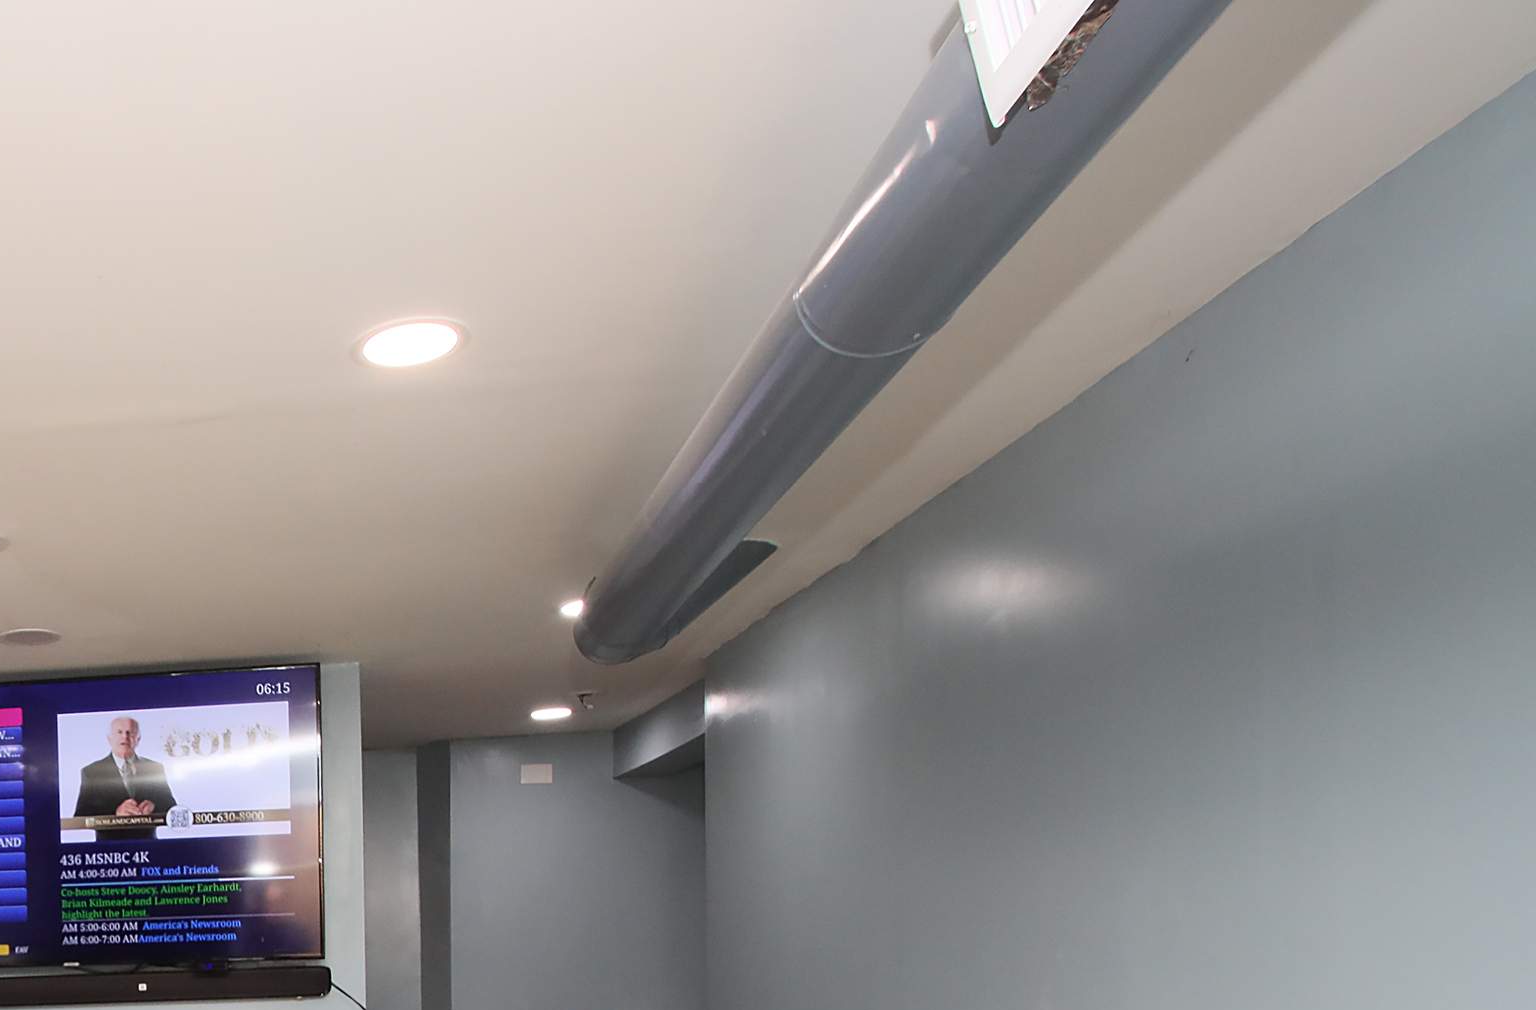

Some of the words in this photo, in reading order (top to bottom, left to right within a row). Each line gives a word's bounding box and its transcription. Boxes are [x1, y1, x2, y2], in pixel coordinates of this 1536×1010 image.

[257, 683, 290, 695] 06:15
[195, 811, 264, 824] 800-630-8900
[60, 855, 82, 866] 436
[85, 853, 129, 865] MSNBC
[132, 852, 149, 863] 4K
[60, 871, 76, 879] AM
[78, 869, 119, 878] 4:00-5:00
[121, 868, 137, 877] AM
[142, 867, 161, 876] FOX
[163, 866, 181, 875] and
[183, 865, 219, 874] Friends
[61, 888, 99, 897] Co-hosts
[101, 887, 126, 896] Steve
[161, 884, 195, 896] Ainsley
[197, 883, 242, 893] Earhardt,
[62, 899, 87, 908] Brian
[89, 898, 132, 907] Kilmeade
[134, 897, 152, 906] and
[155, 896, 200, 906] Lawrence
[202, 895, 228, 905] Jones
[62, 910, 103, 920] highlight
[105, 909, 120, 918] the
[62, 924, 77, 932] AM
[80, 922, 120, 932] 5:00-6:00
[122, 922, 138, 931] AM
[143, 920, 189, 931] America's
[191, 919, 241, 929] Newsroom
[63, 936, 78, 945] AM
[81, 935, 120, 944] 6:00-7:00
[122, 935, 138, 944] AM
[138, 933, 184, 943] America's
[186, 932, 236, 942] Newsroom
[14, 946, 28, 954] FAV
